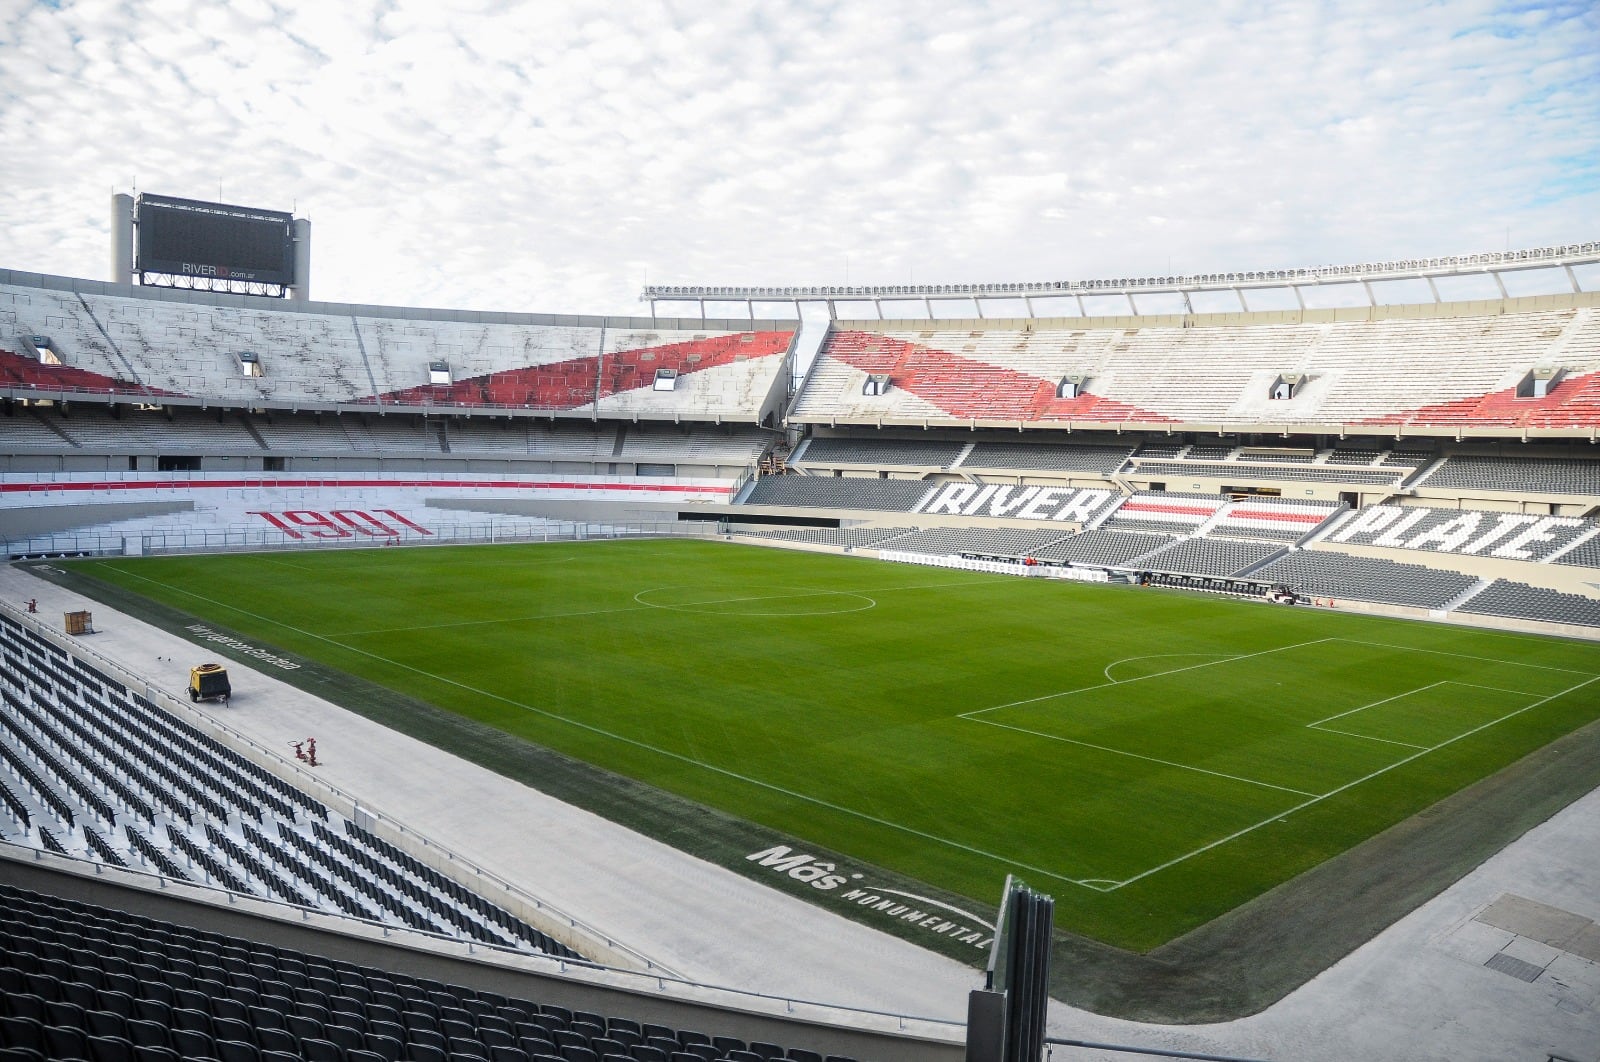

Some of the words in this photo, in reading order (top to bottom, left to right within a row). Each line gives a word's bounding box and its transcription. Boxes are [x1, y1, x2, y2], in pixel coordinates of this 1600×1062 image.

[245, 509, 434, 539] 1901
[926, 482, 1111, 522] RIVER
[1332, 505, 1585, 559] PLATE
[841, 889, 994, 949] MONUMENTAL
